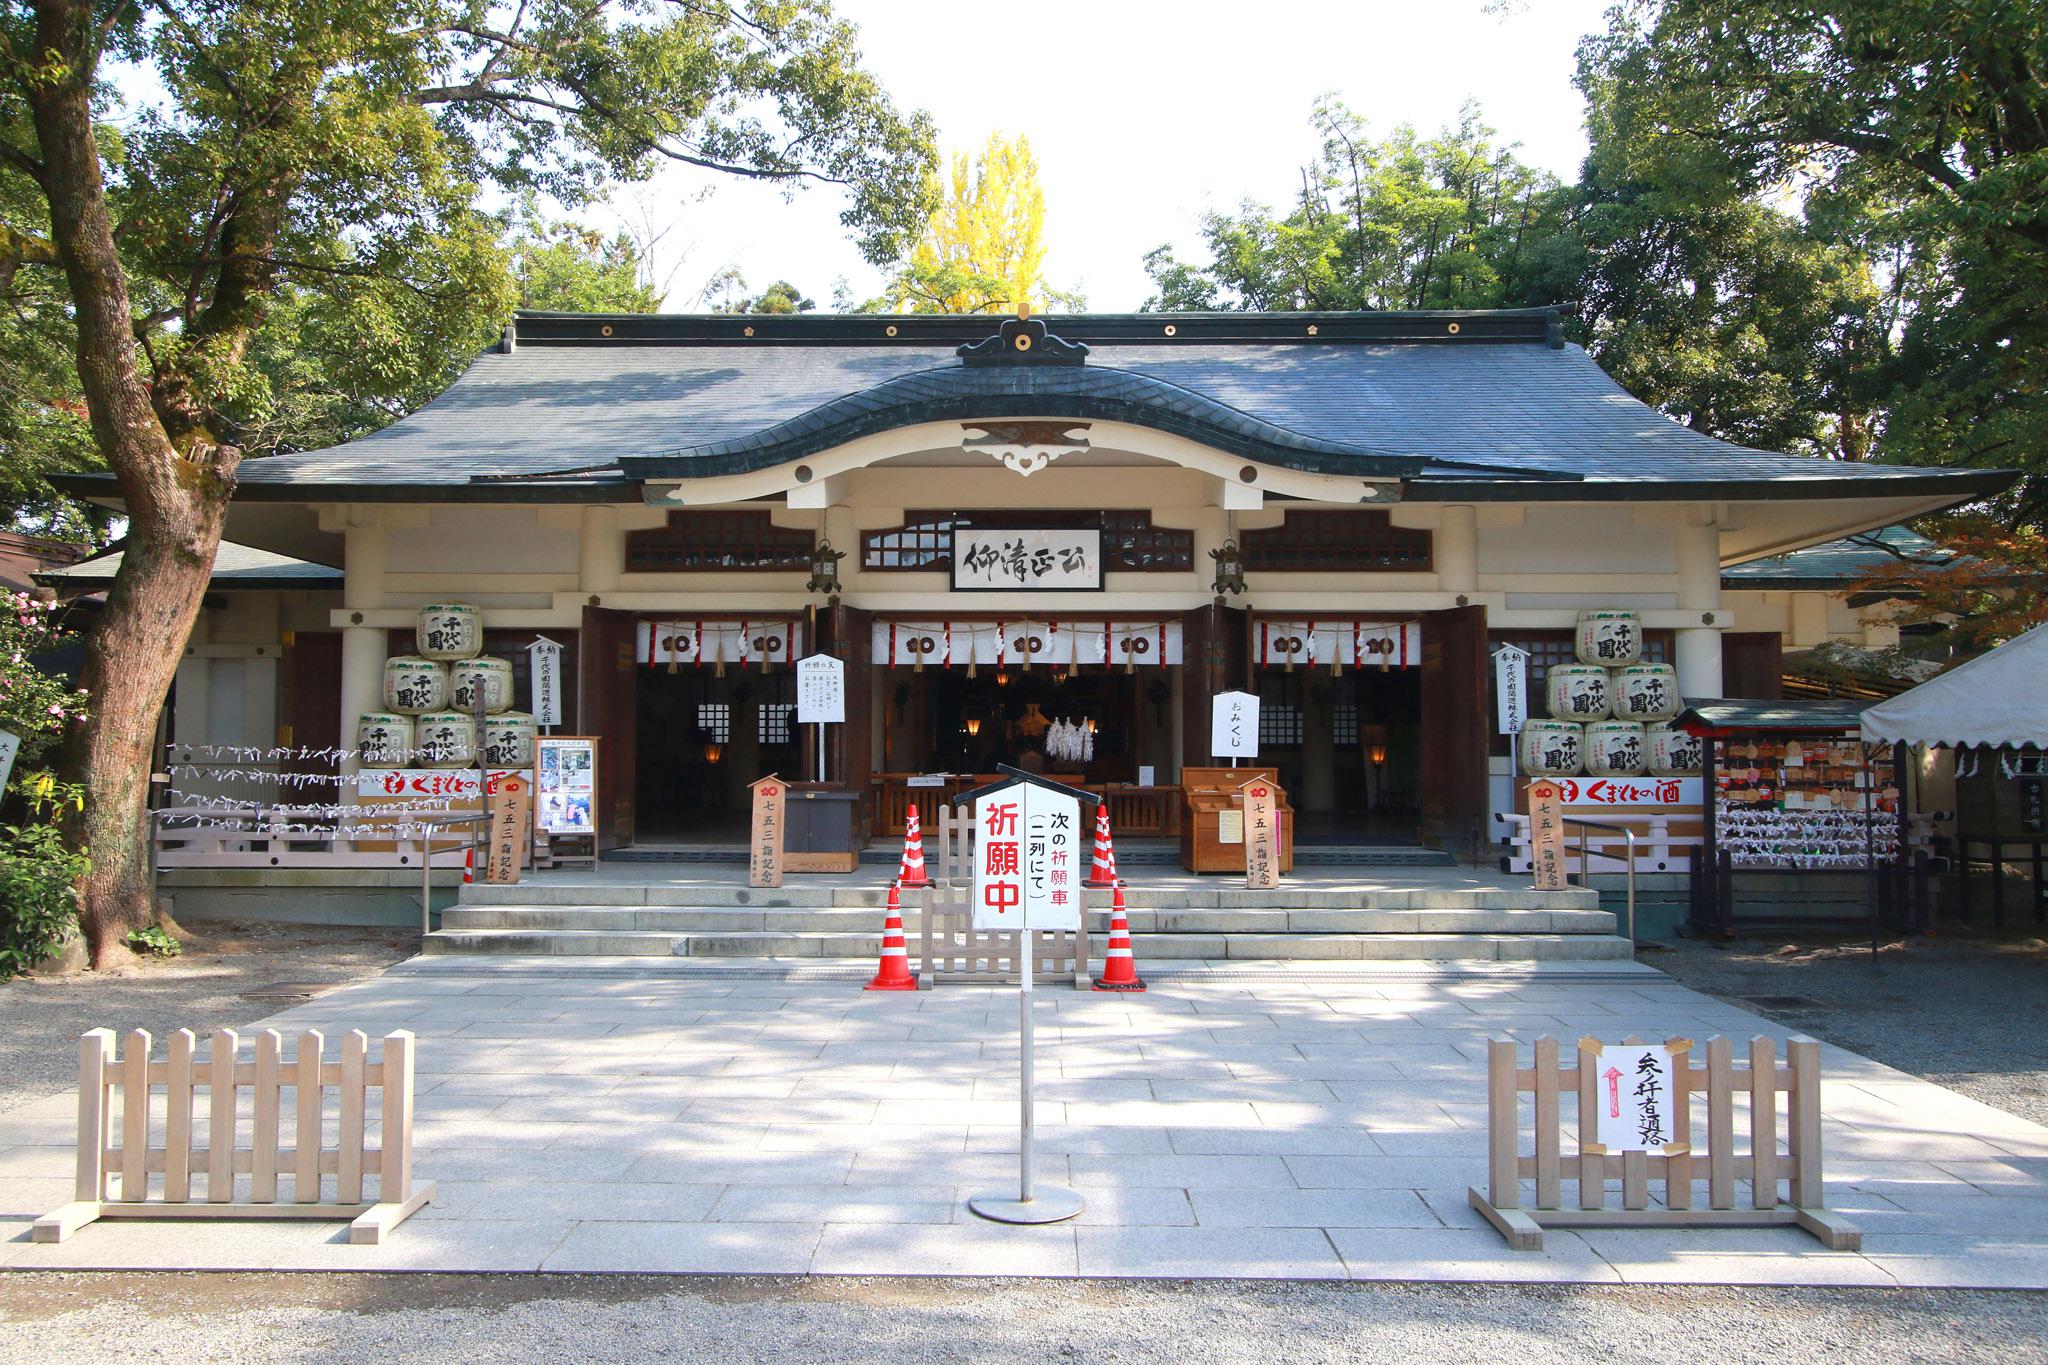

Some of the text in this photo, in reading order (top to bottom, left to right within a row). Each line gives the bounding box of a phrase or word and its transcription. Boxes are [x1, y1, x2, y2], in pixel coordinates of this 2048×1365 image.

[1230, 702, 1242, 748] おみくじ
[1586, 779, 1682, 804] くまもとの酒
[499, 799, 517, 881] 七五三詣記念
[761, 800, 775, 883] 七五三詣記念
[985, 802, 1019, 914] 祈願中
[1050, 812, 1069, 907] 次の祈願車
[1253, 803, 1270, 885] 七五三詣記念
[1538, 803, 1558, 886] 七五三詣記念
